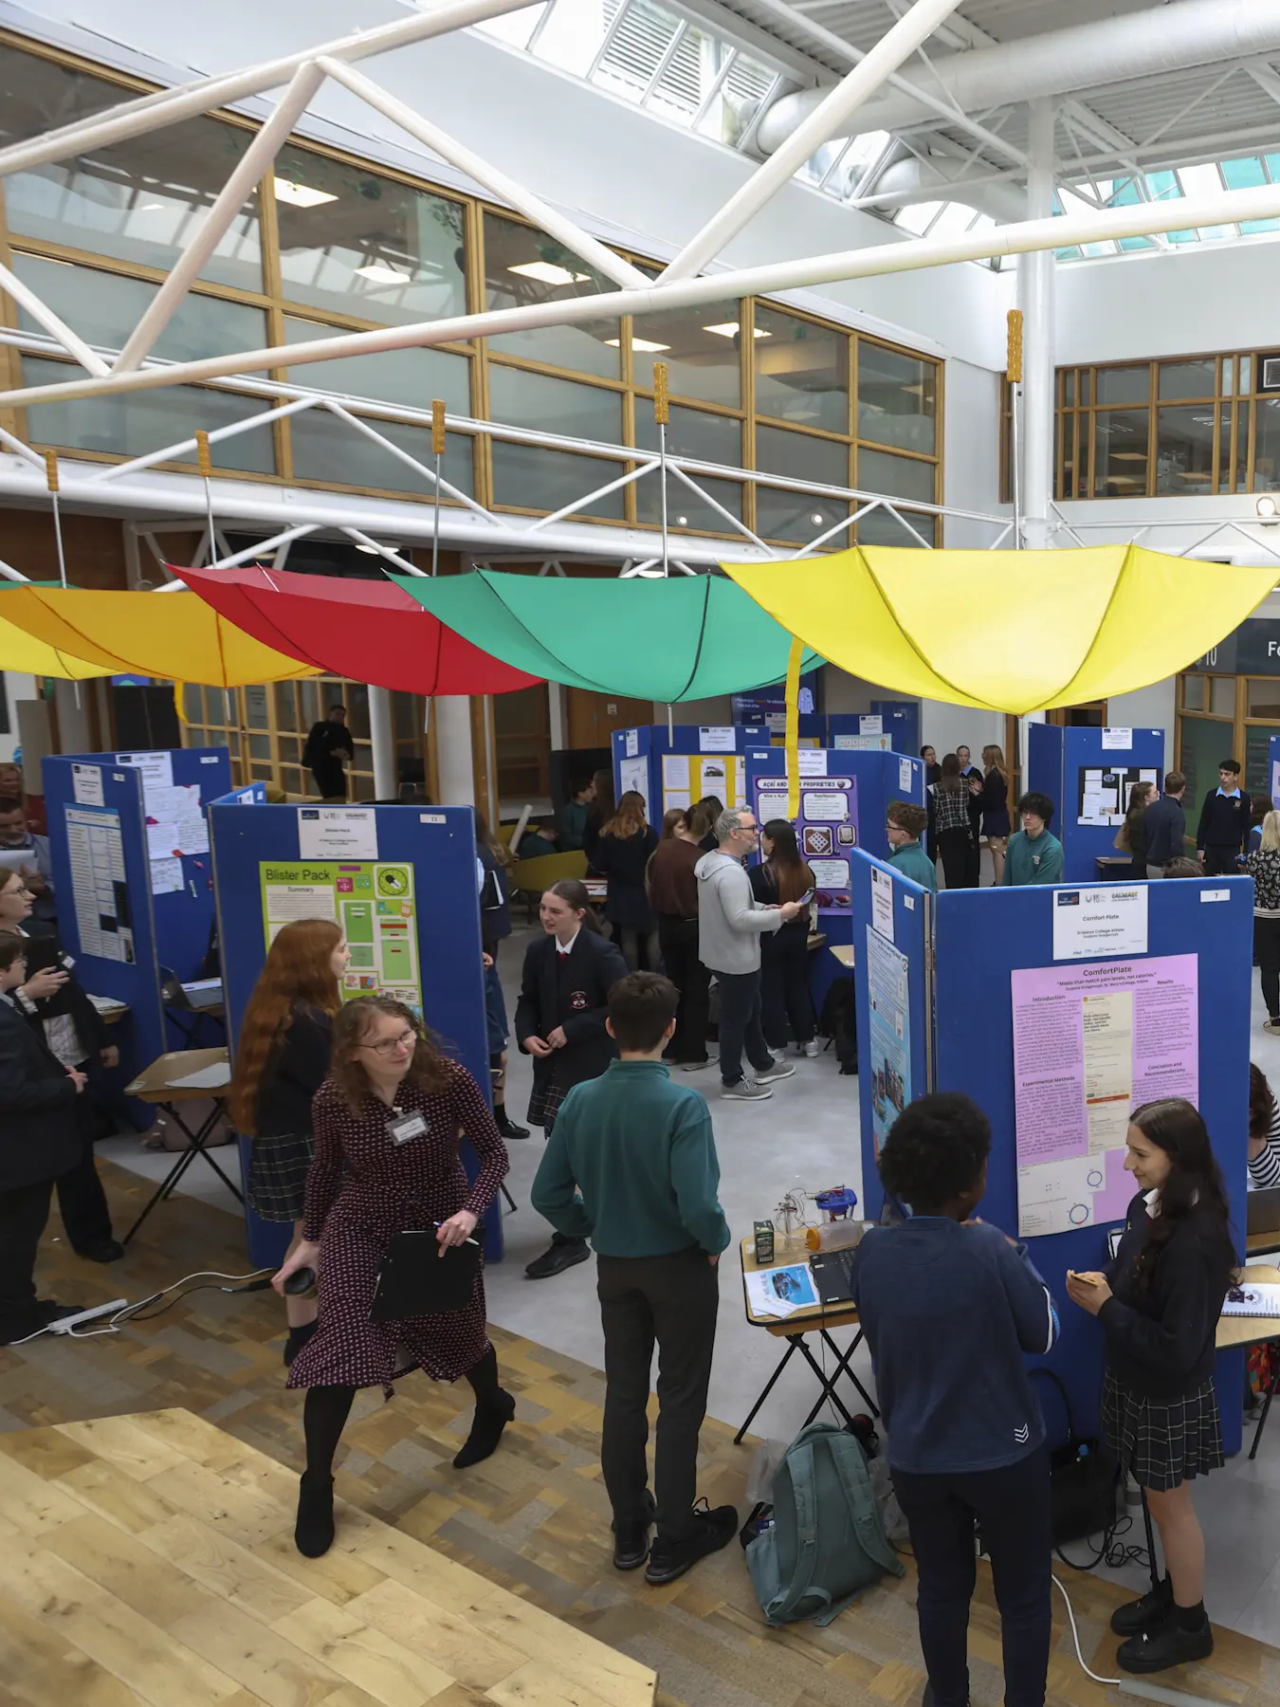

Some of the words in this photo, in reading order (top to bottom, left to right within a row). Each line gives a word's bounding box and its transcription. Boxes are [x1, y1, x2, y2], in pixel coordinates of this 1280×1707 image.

[266, 869, 299, 881] Blister
[302, 869, 331, 881] Pack
[288, 886, 314, 894] Summary
[1083, 966, 1132, 977] ComfortPlate
[1032, 994, 1066, 1002] Introduction
[1148, 1063, 1172, 1071] Conclusion
[1022, 1079, 1053, 1088] Experimental
[1054, 1075, 1075, 1084] Methods
